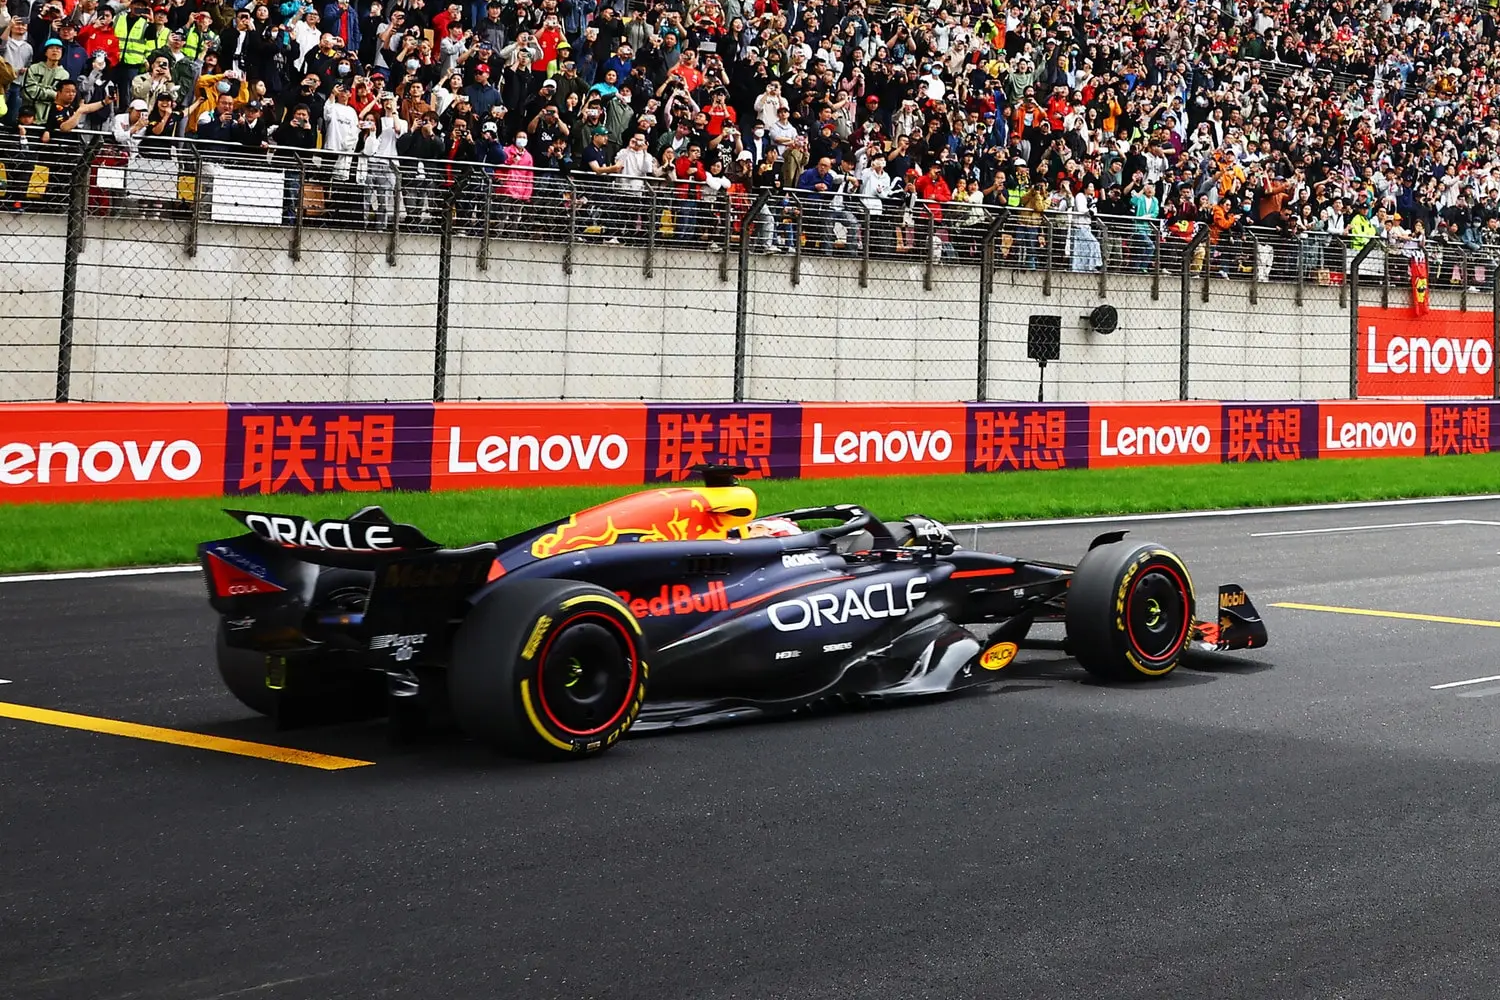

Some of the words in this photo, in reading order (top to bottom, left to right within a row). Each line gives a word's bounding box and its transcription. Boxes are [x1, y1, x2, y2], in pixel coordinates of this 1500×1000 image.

[1368, 326, 1493, 374] Lenovo
[449, 427, 628, 472] Lenovo
[656, 413, 772, 481] 联想
[813, 423, 952, 463] Lenovo
[974, 410, 1066, 471] 联想
[1101, 420, 1210, 455] Lenovo
[1228, 409, 1300, 461] 联想
[1326, 416, 1416, 449] Lenovo
[1431, 407, 1489, 456] 联想
[239, 415, 395, 493] 联想
[246, 515, 393, 550] ORACLE
[228, 585, 259, 596] COLA
[672, 580, 728, 615] Bull
[767, 577, 928, 632] ORACLE
[1220, 592, 1245, 606] Mobil
[386, 632, 428, 648] Player
